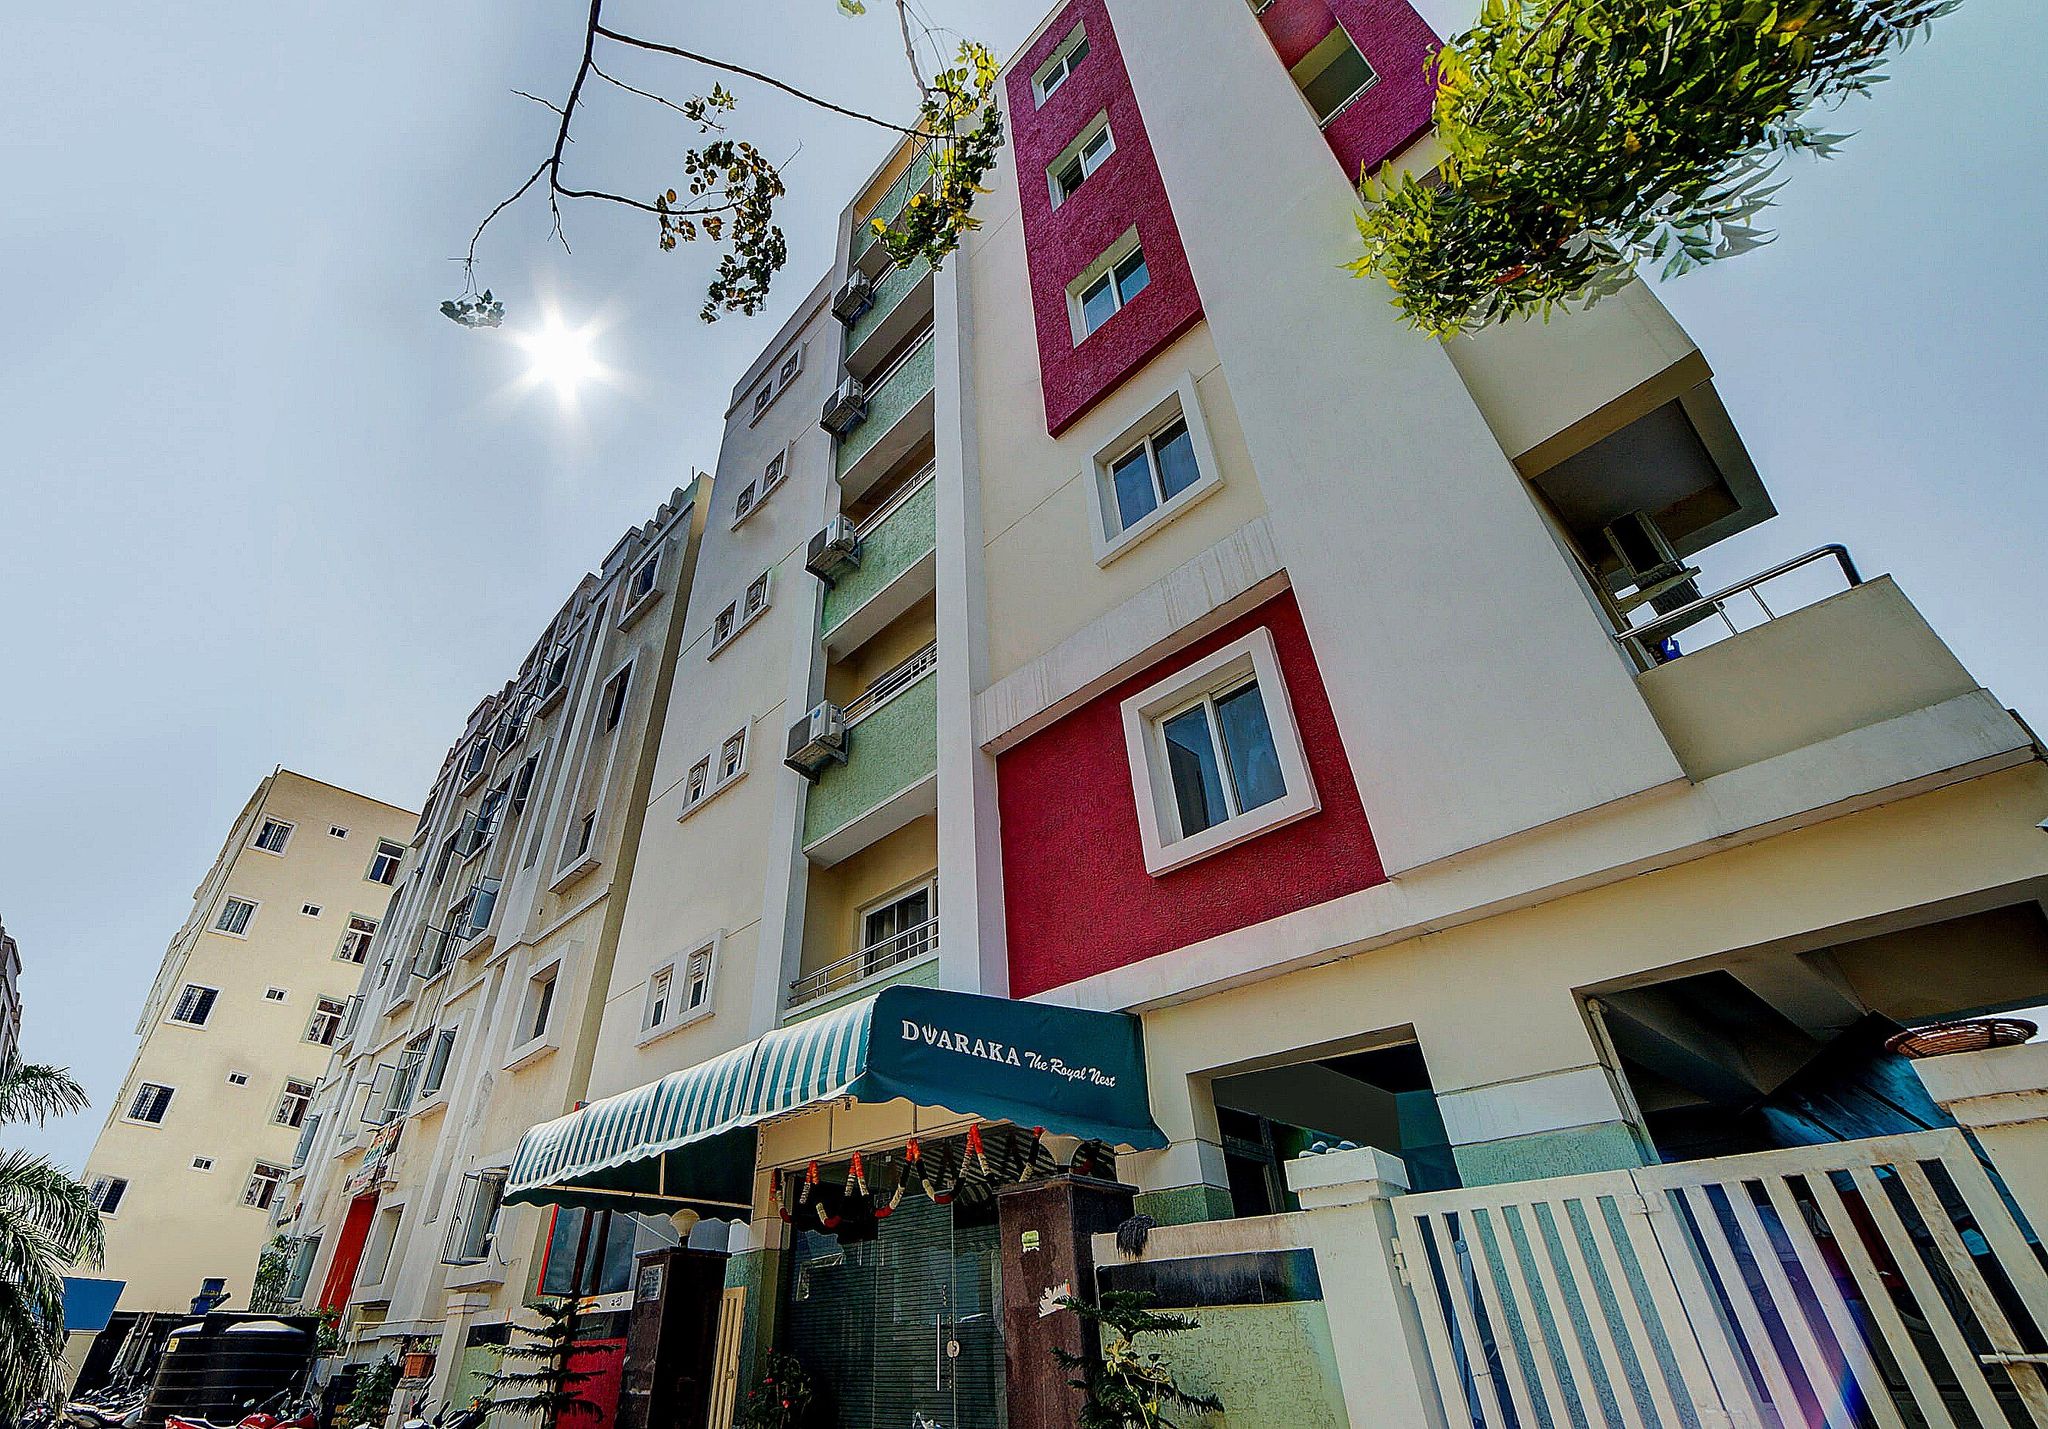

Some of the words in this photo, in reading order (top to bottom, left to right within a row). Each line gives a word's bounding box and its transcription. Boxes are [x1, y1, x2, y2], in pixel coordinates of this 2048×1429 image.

[1024, 1052, 1048, 1071] The
[1050, 1058, 1086, 1082] Royal
[1088, 1067, 1116, 1088] Nest
